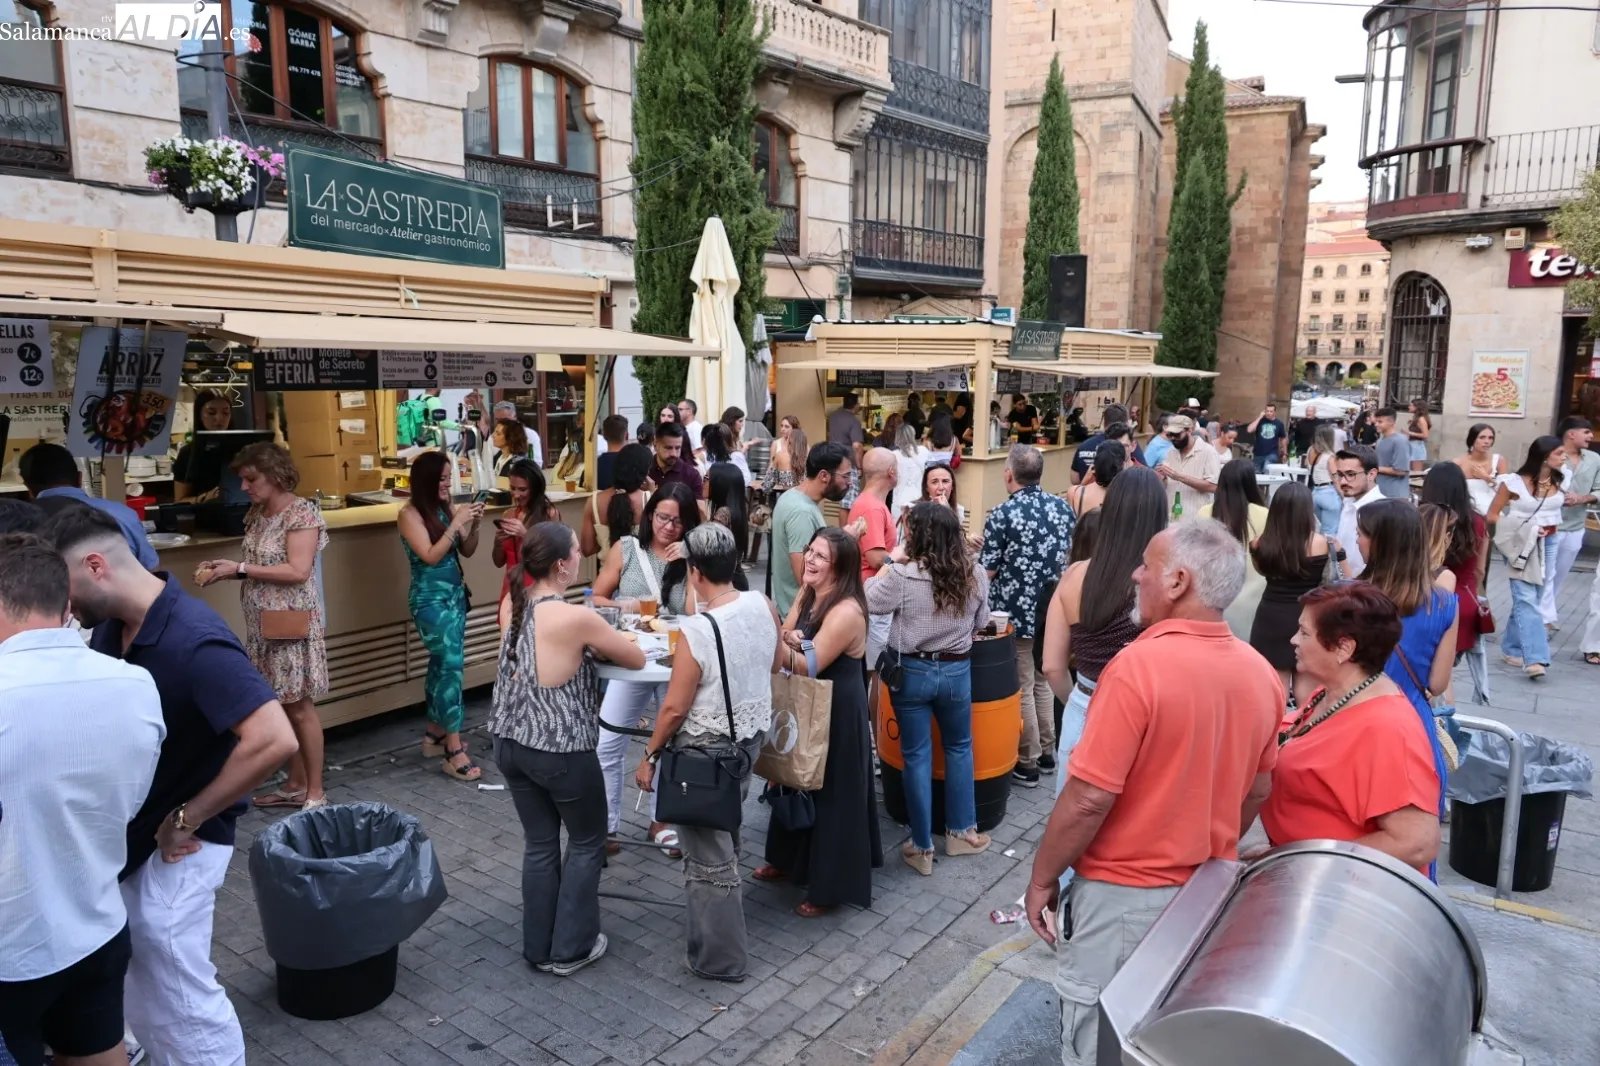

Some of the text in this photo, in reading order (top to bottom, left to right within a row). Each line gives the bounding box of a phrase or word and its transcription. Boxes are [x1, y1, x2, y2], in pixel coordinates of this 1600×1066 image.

[288, 28, 316, 41] GÓMEZ
[289, 37, 316, 49] BARBA
[304, 173, 492, 238] LA SASTRERIA
[310, 213, 329, 227] del
[334, 219, 385, 236] mercado
[424, 233, 491, 252] gastronómico
[23, 346, 36, 359] 7€
[319, 358, 366, 370] de Secreto
[23, 369, 43, 381] 12€
[265, 363, 316, 384] DE FERIA
[1496, 367, 1509, 381] 5
